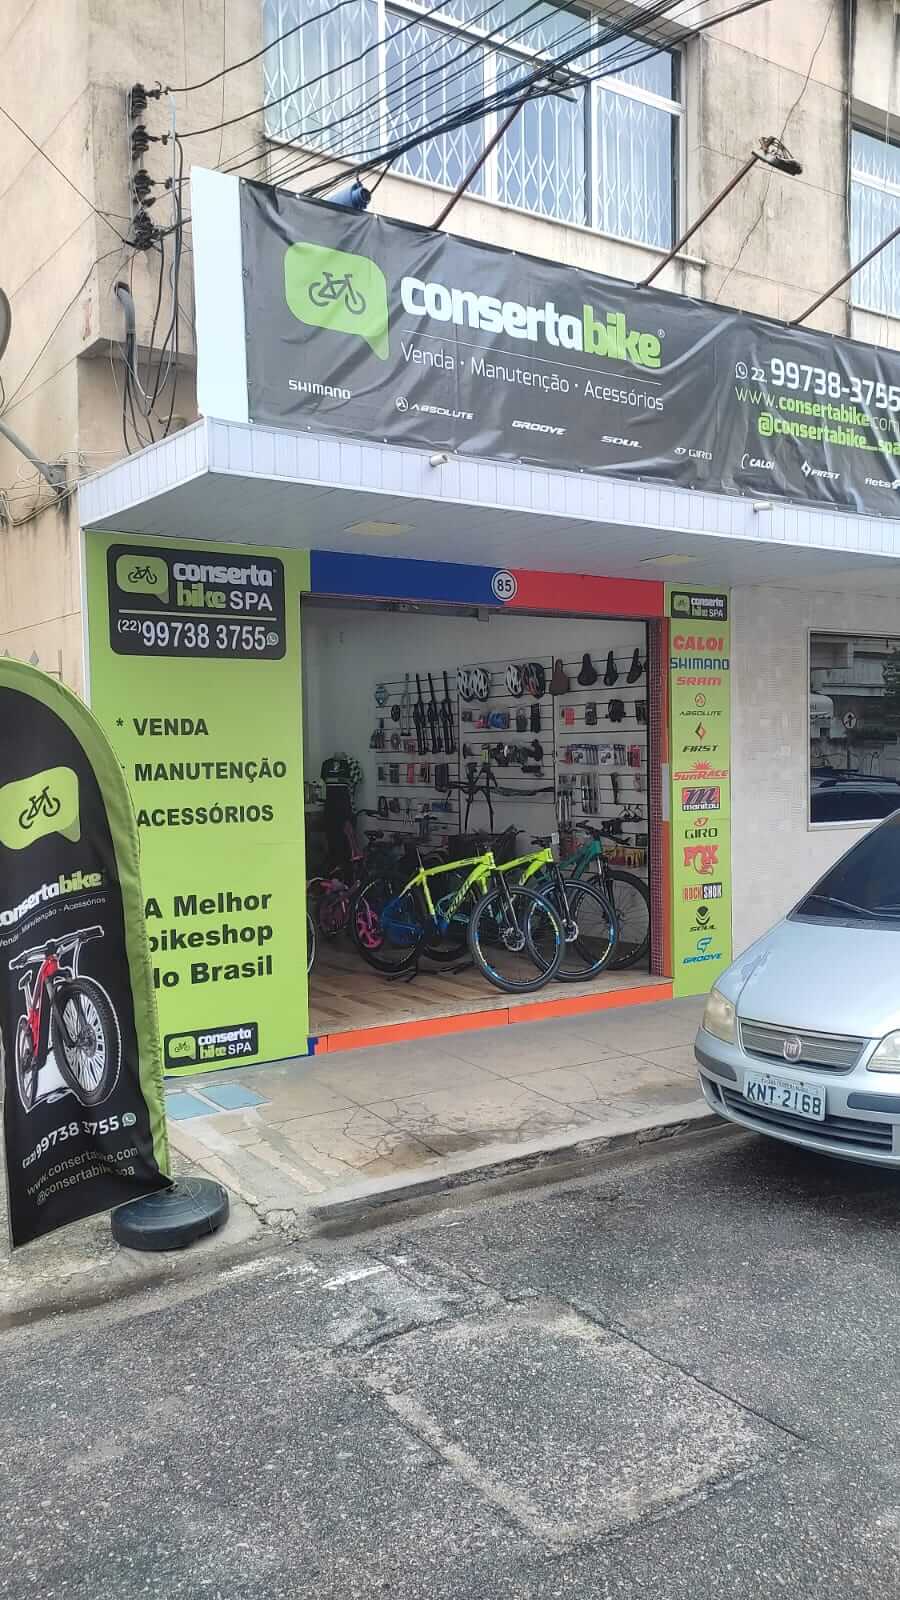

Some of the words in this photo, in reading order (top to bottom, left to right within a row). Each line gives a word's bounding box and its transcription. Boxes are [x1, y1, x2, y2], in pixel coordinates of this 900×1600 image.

[400, 276, 662, 368] consertabike
[401, 342, 454, 370] Venda
[471, 358, 570, 394] Manutenção
[584, 380, 664, 411] Acessórios
[751, 367, 768, 383] 22
[288, 379, 350, 400] SHIMANO
[410, 404, 474, 420] ABSOLUTE
[511, 419, 567, 435] GROOVE
[600, 435, 643, 448] SOUL
[688, 449, 712, 460] GIRO
[749, 458, 775, 471] CALOI
[811, 469, 840, 481] FIRST
[173, 562, 273, 587] conserta
[495, 579, 512, 593] 85
[176, 582, 226, 609] bike
[229, 590, 273, 612] SPA
[708, 608, 724, 618] SPA
[215, 624, 266, 651] 3755
[673, 635, 725, 652] CALOI
[670, 657, 730, 670] SHIMANO
[676, 676, 721, 686] SRAM
[133, 717, 209, 736] VENDA
[682, 744, 719, 753] FIRST
[134, 757, 287, 784] MANUTENÇÃO
[136, 803, 274, 827] ACESSÓRIOS
[683, 803, 720, 812] manitou
[685, 828, 718, 840] GIRO
[683, 845, 720, 876] FOX
[0, 870, 103, 927] onsertabike
[144, 897, 163, 920] A
[173, 890, 273, 918] Melhor
[682, 953, 723, 964] GROOVE
[191, 955, 273, 984] Brasil
[198, 1028, 252, 1046] conserta
[228, 1041, 253, 1056] SPA
[82, 1115, 120, 1136] 3755
